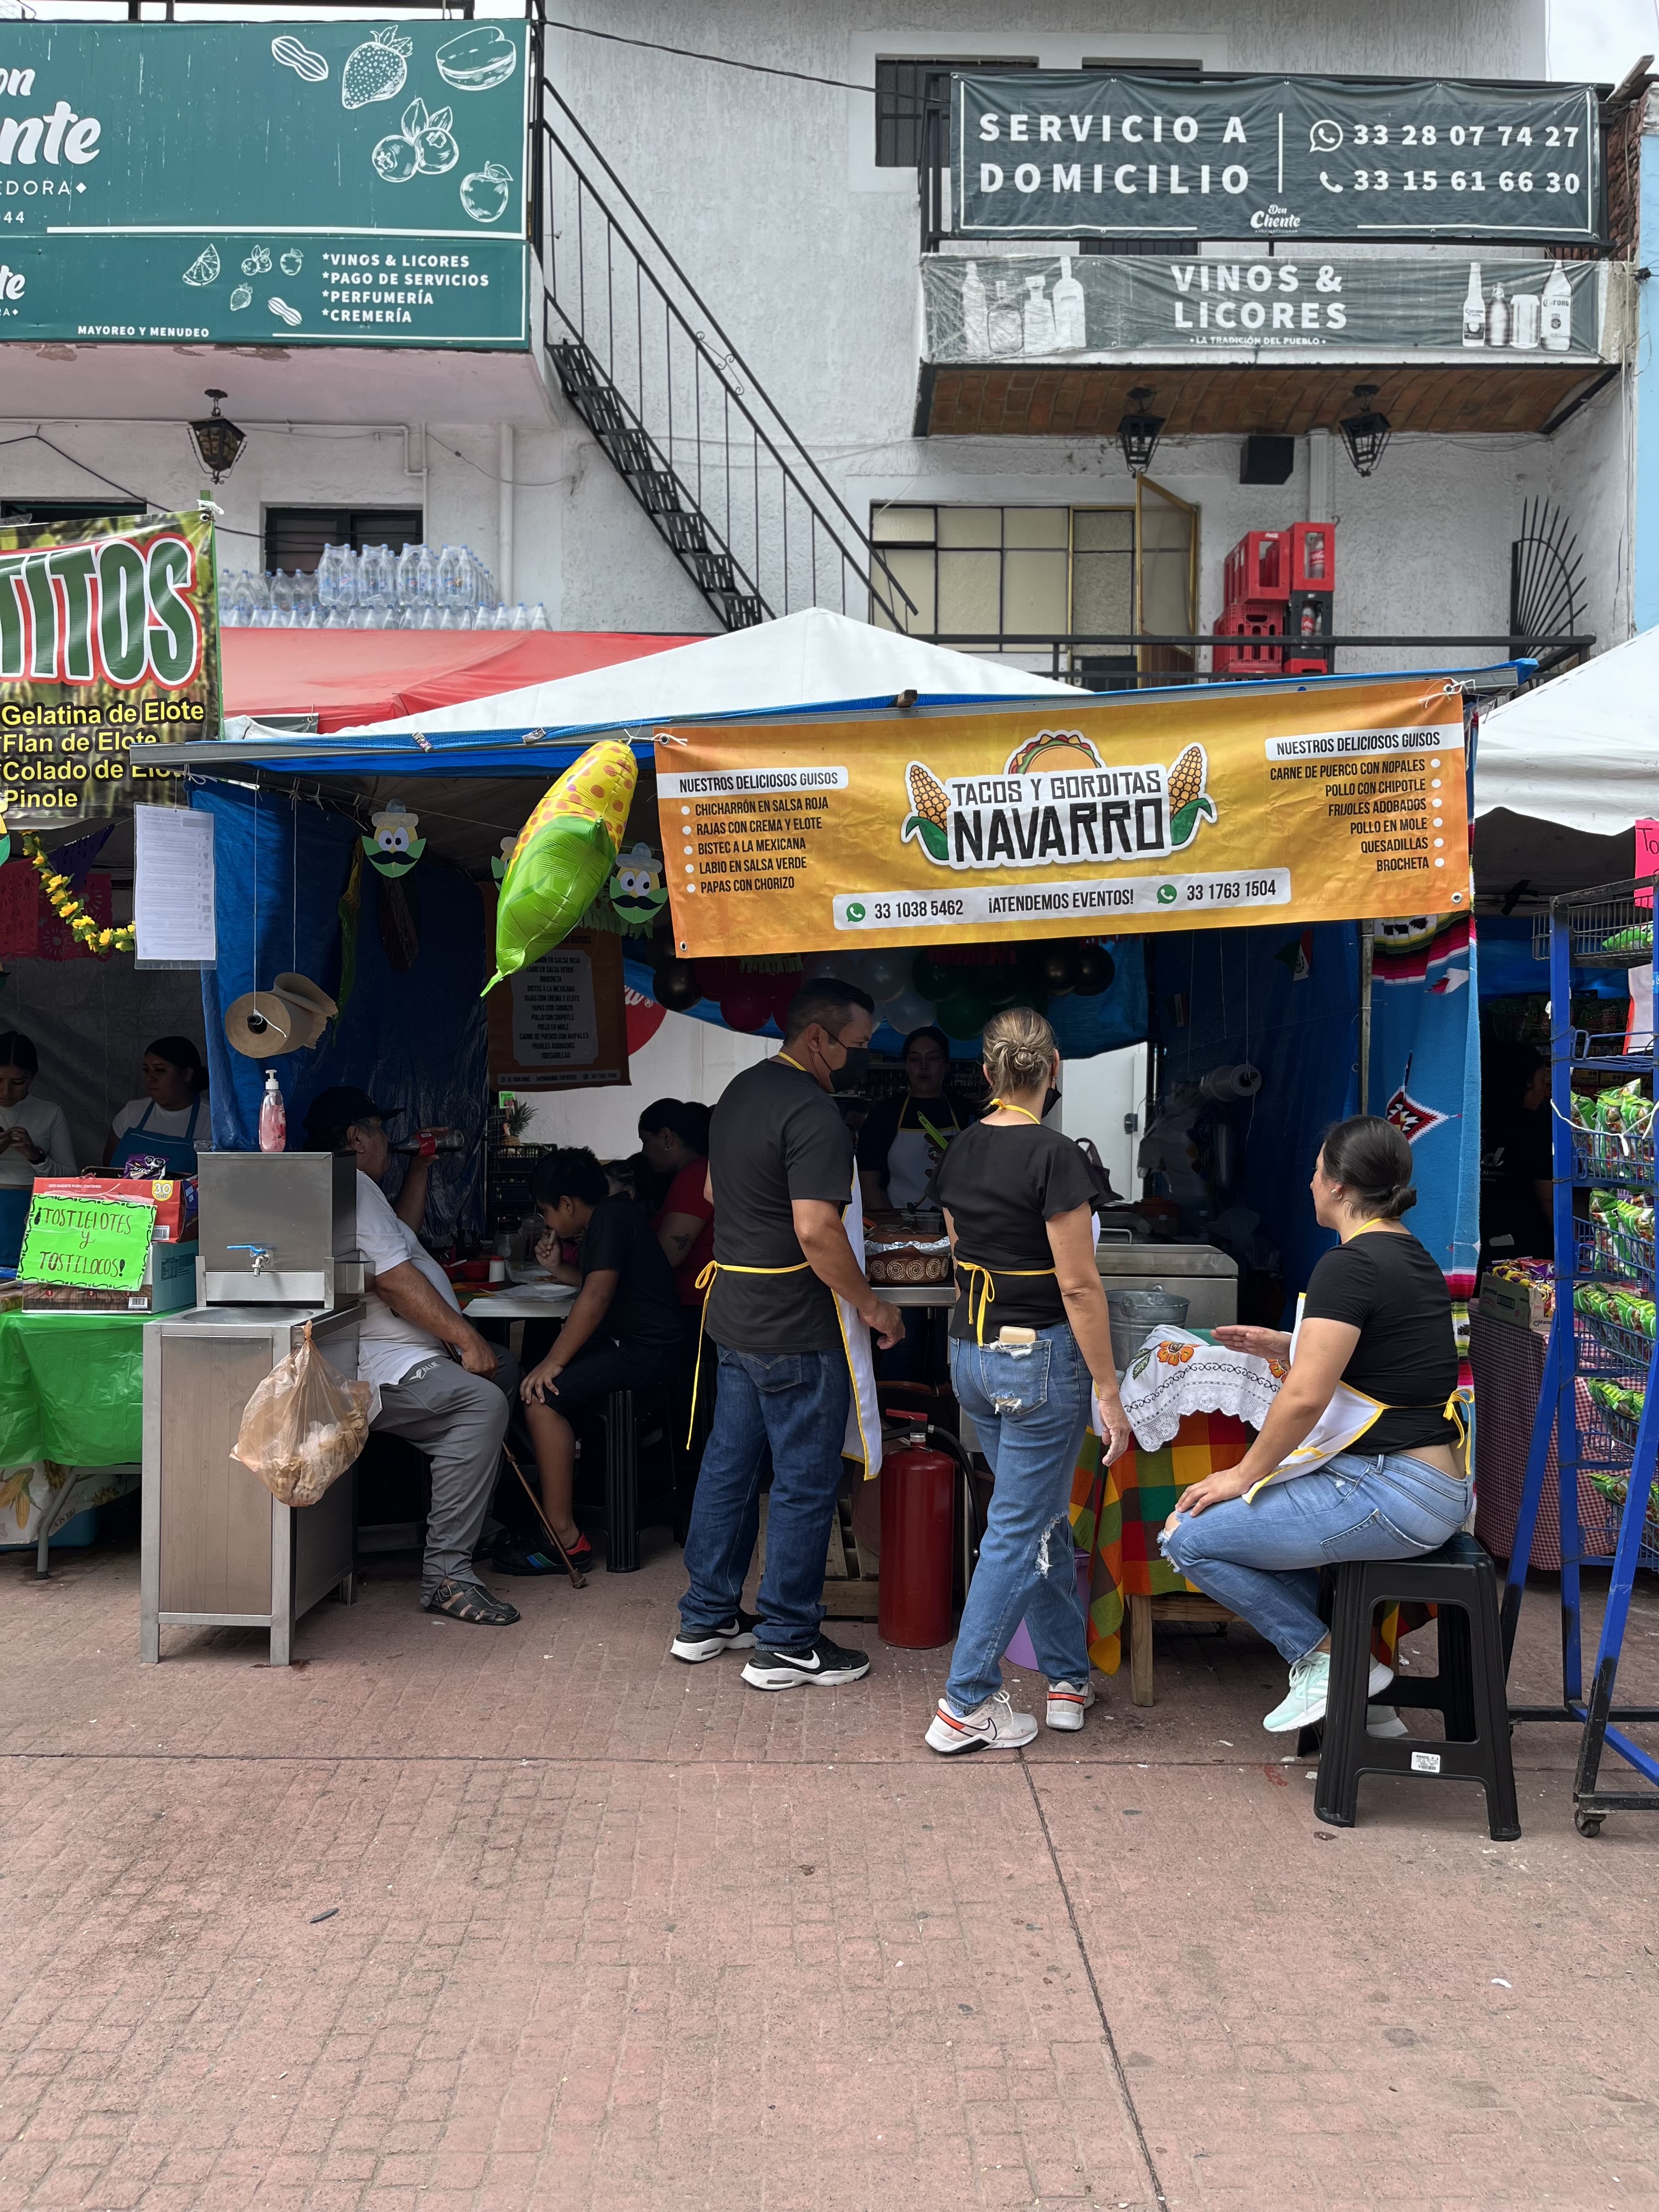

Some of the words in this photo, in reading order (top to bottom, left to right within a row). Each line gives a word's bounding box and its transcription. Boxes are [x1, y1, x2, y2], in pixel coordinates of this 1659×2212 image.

[979, 114, 1198, 143] SERVICIO
[1223, 117, 1246, 143] A
[1354, 125, 1388, 144] 33
[1402, 125, 1436, 145] 28
[1450, 126, 1484, 145] 07
[1498, 126, 1532, 146] 74
[1545, 126, 1578, 147] 27
[0, 180, 70, 195] DORA
[981, 163, 1248, 194] DOMICILIO
[1354, 170, 1389, 190] 33
[1404, 171, 1437, 190] 15
[1451, 171, 1485, 190] 61
[1499, 171, 1533, 191] 66
[1546, 172, 1579, 194] 30
[0, 211, 25, 224] 44
[1268, 204, 1287, 215] Don
[1250, 211, 1301, 229] Chente
[386, 255, 396, 266] &
[403, 255, 469, 267] LICORES
[379, 273, 398, 284] DE
[405, 274, 488, 286] SERVICIOS
[1170, 265, 1299, 292] VINOS
[1316, 266, 1342, 292] &
[1175, 302, 1347, 329] LICORES
[78, 326, 134, 335] MAYOREO
[139, 327, 146, 335] Y
[150, 328, 208, 337] MENUDEO
[2, 704, 101, 726] Gelatina
[109, 703, 137, 724] de
[145, 700, 204, 722] Elote
[3, 733, 53, 753] Flan
[61, 732, 89, 752] de
[1277, 738, 1334, 755] NUESTROS
[1338, 735, 1399, 751] DELICIOSOS
[1402, 732, 1440, 747] GUISOS
[3, 760, 87, 781] Colado
[95, 760, 123, 779] de
[1271, 766, 1302, 780] CARNE
[1305, 766, 1317, 778] DE
[1320, 764, 1357, 777] PUERCO
[1361, 762, 1379, 775] CON
[1382, 759, 1425, 774] NOPALES
[680, 777, 733, 792] NUESTROS
[736, 774, 797, 789] DELICIOSOS
[800, 772, 838, 786] GUISOS
[952, 780, 1022, 806] TACOS
[1030, 778, 1041, 801] Y
[1050, 770, 1161, 799] GORDITAS
[1325, 783, 1355, 797] POLLO
[1358, 782, 1376, 794] CON
[1378, 778, 1426, 793] CHIPOTLE
[4, 788, 77, 808] Pinole
[696, 799, 756, 816] CHICHARRÓN
[758, 800, 770, 812] EN
[772, 798, 803, 811] SALSA
[805, 797, 828, 810] ROJA
[1329, 802, 1370, 816] FRIJOLES
[1373, 798, 1426, 814] ADOBADOS
[697, 822, 726, 835] RAJAS
[729, 821, 747, 833] CON
[750, 819, 783, 832] CREMA
[785, 819, 791, 830] Y
[793, 817, 822, 830] ELOTE
[953, 798, 1165, 862] NAVARRO
[1351, 821, 1380, 834] POLLO
[1384, 820, 1397, 832] EN
[1400, 817, 1427, 831] MOLE
[698, 842, 731, 855] BISTEC
[733, 841, 740, 853] A
[742, 840, 754, 852] LA
[756, 837, 806, 851] MEXICANA
[1361, 837, 1428, 853] QUESADILLAS
[699, 861, 726, 874] LABIO
[730, 860, 741, 872] EN
[744, 859, 774, 871] SALSA
[776, 857, 806, 870] VERDE
[1377, 856, 1429, 872] BROCHETA
[701, 880, 731, 893] PAPAS
[733, 879, 752, 891] CON
[754, 877, 794, 890] CHORIZO
[875, 904, 890, 918] 33
[896, 901, 927, 917] 1038
[931, 900, 963, 916] 5462
[989, 893, 1069, 913] ¡ATENDEMOS
[1073, 889, 1133, 907] EVENTOS!
[1187, 885, 1203, 900] 33
[1209, 883, 1240, 899] 1763
[1245, 880, 1276, 896] 1504
[154, 1183, 172, 1195] 30
[40, 1251, 126, 1278] TOSTILOCOS!
